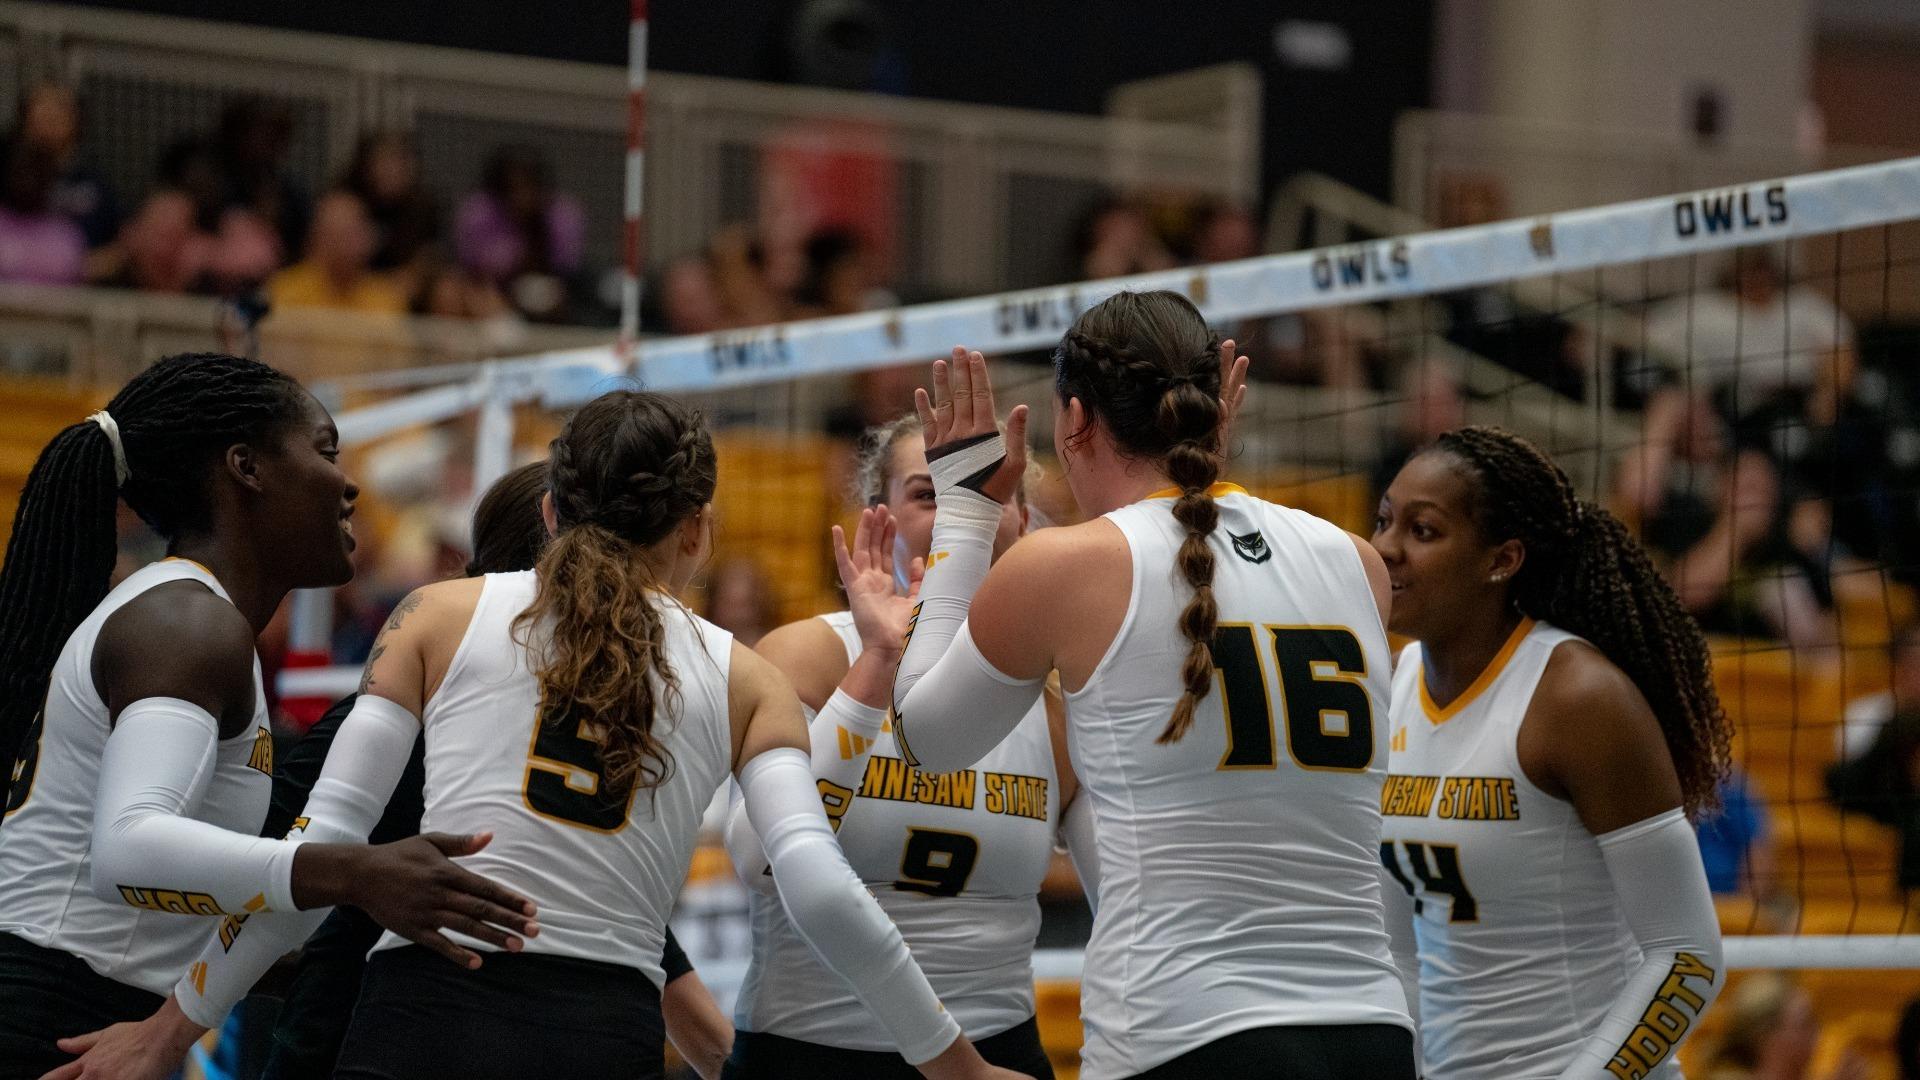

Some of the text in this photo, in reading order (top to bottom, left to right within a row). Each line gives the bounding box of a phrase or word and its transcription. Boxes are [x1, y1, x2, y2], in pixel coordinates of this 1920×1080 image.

[1674, 186, 1788, 237] OWLS
[1311, 241, 1410, 291] OWLS
[1208, 621, 1376, 773] 16
[522, 680, 643, 836] 5
[856, 755, 977, 810] NNESAW
[983, 771, 1049, 822] STATE
[1437, 776, 1520, 820] STATE
[894, 825, 982, 897] 9
[1604, 952, 1715, 1080] HOOTY
